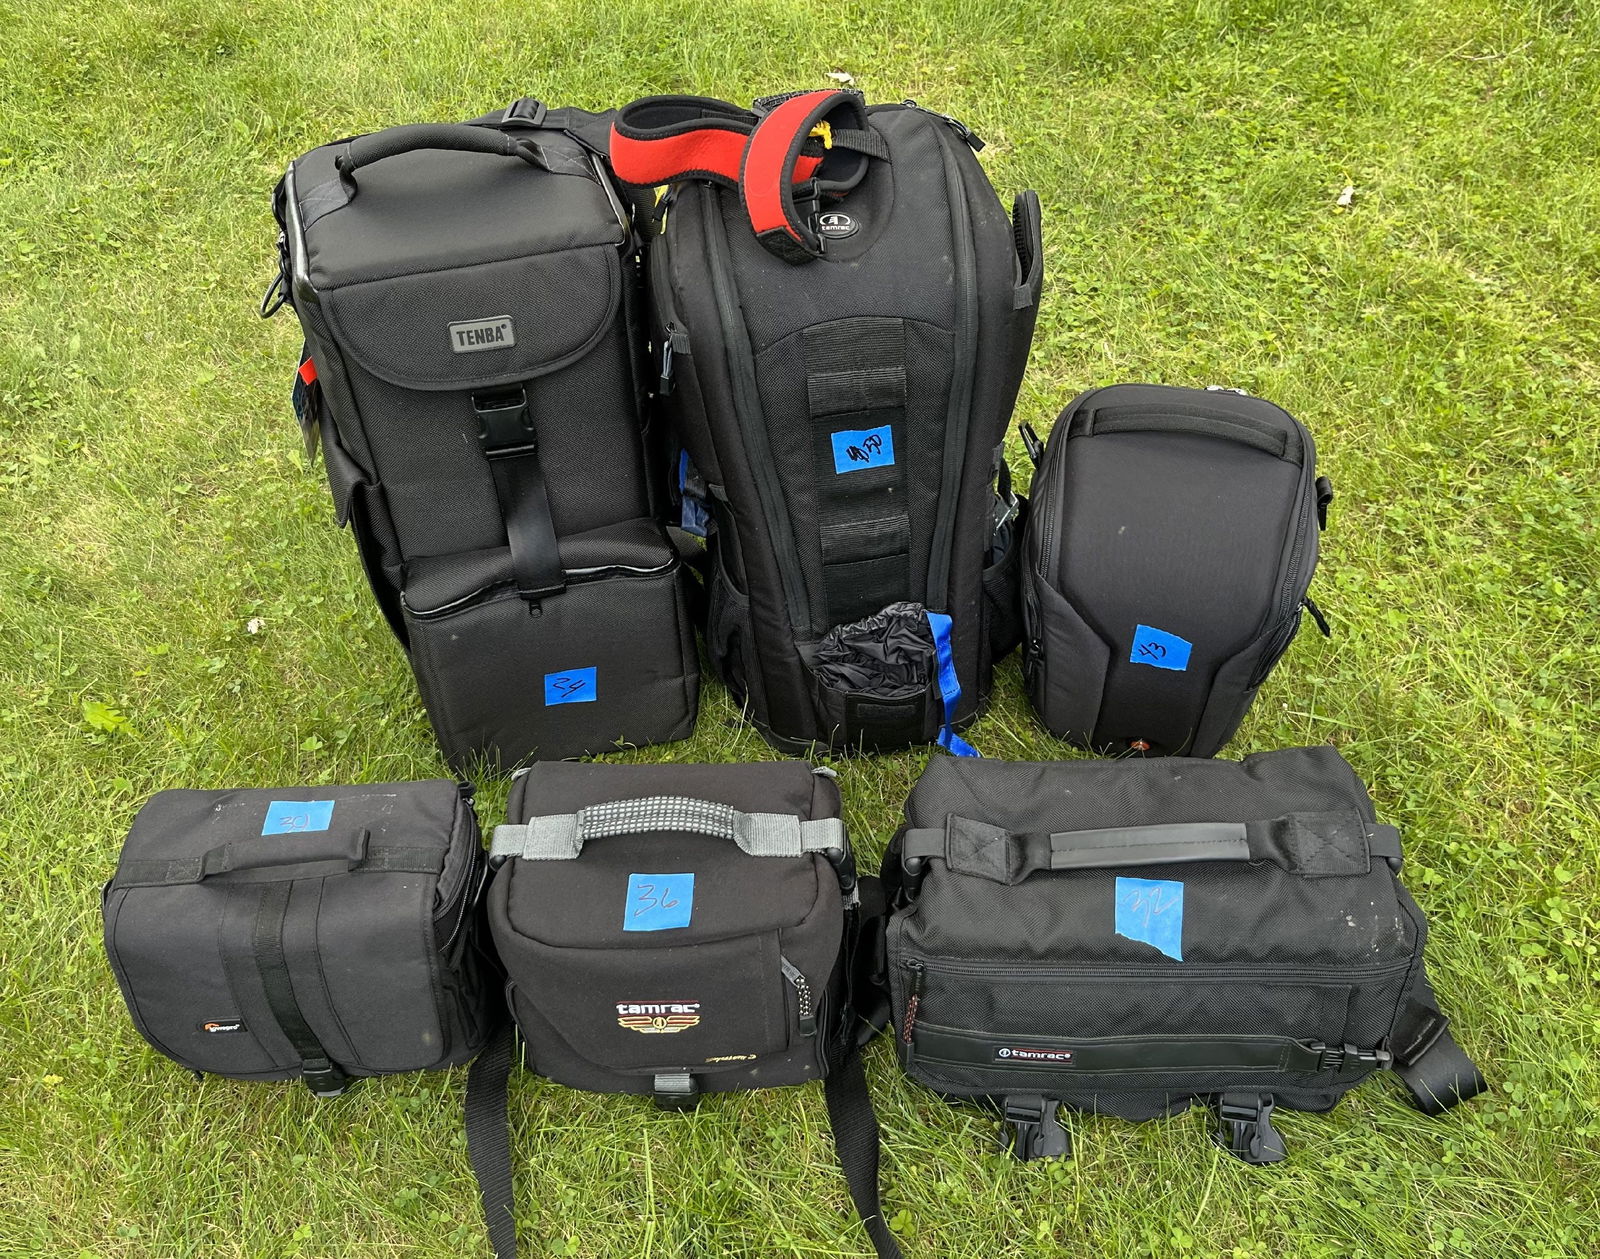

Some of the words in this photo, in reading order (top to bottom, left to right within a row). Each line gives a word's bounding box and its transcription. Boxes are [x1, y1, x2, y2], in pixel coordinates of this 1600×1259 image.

[456, 326, 505, 346] TENBA
[1138, 642, 1167, 660] 43
[634, 884, 679, 917] 36
[616, 1004, 696, 1014] tamrac
[1011, 1049, 1066, 1060] tamrac
